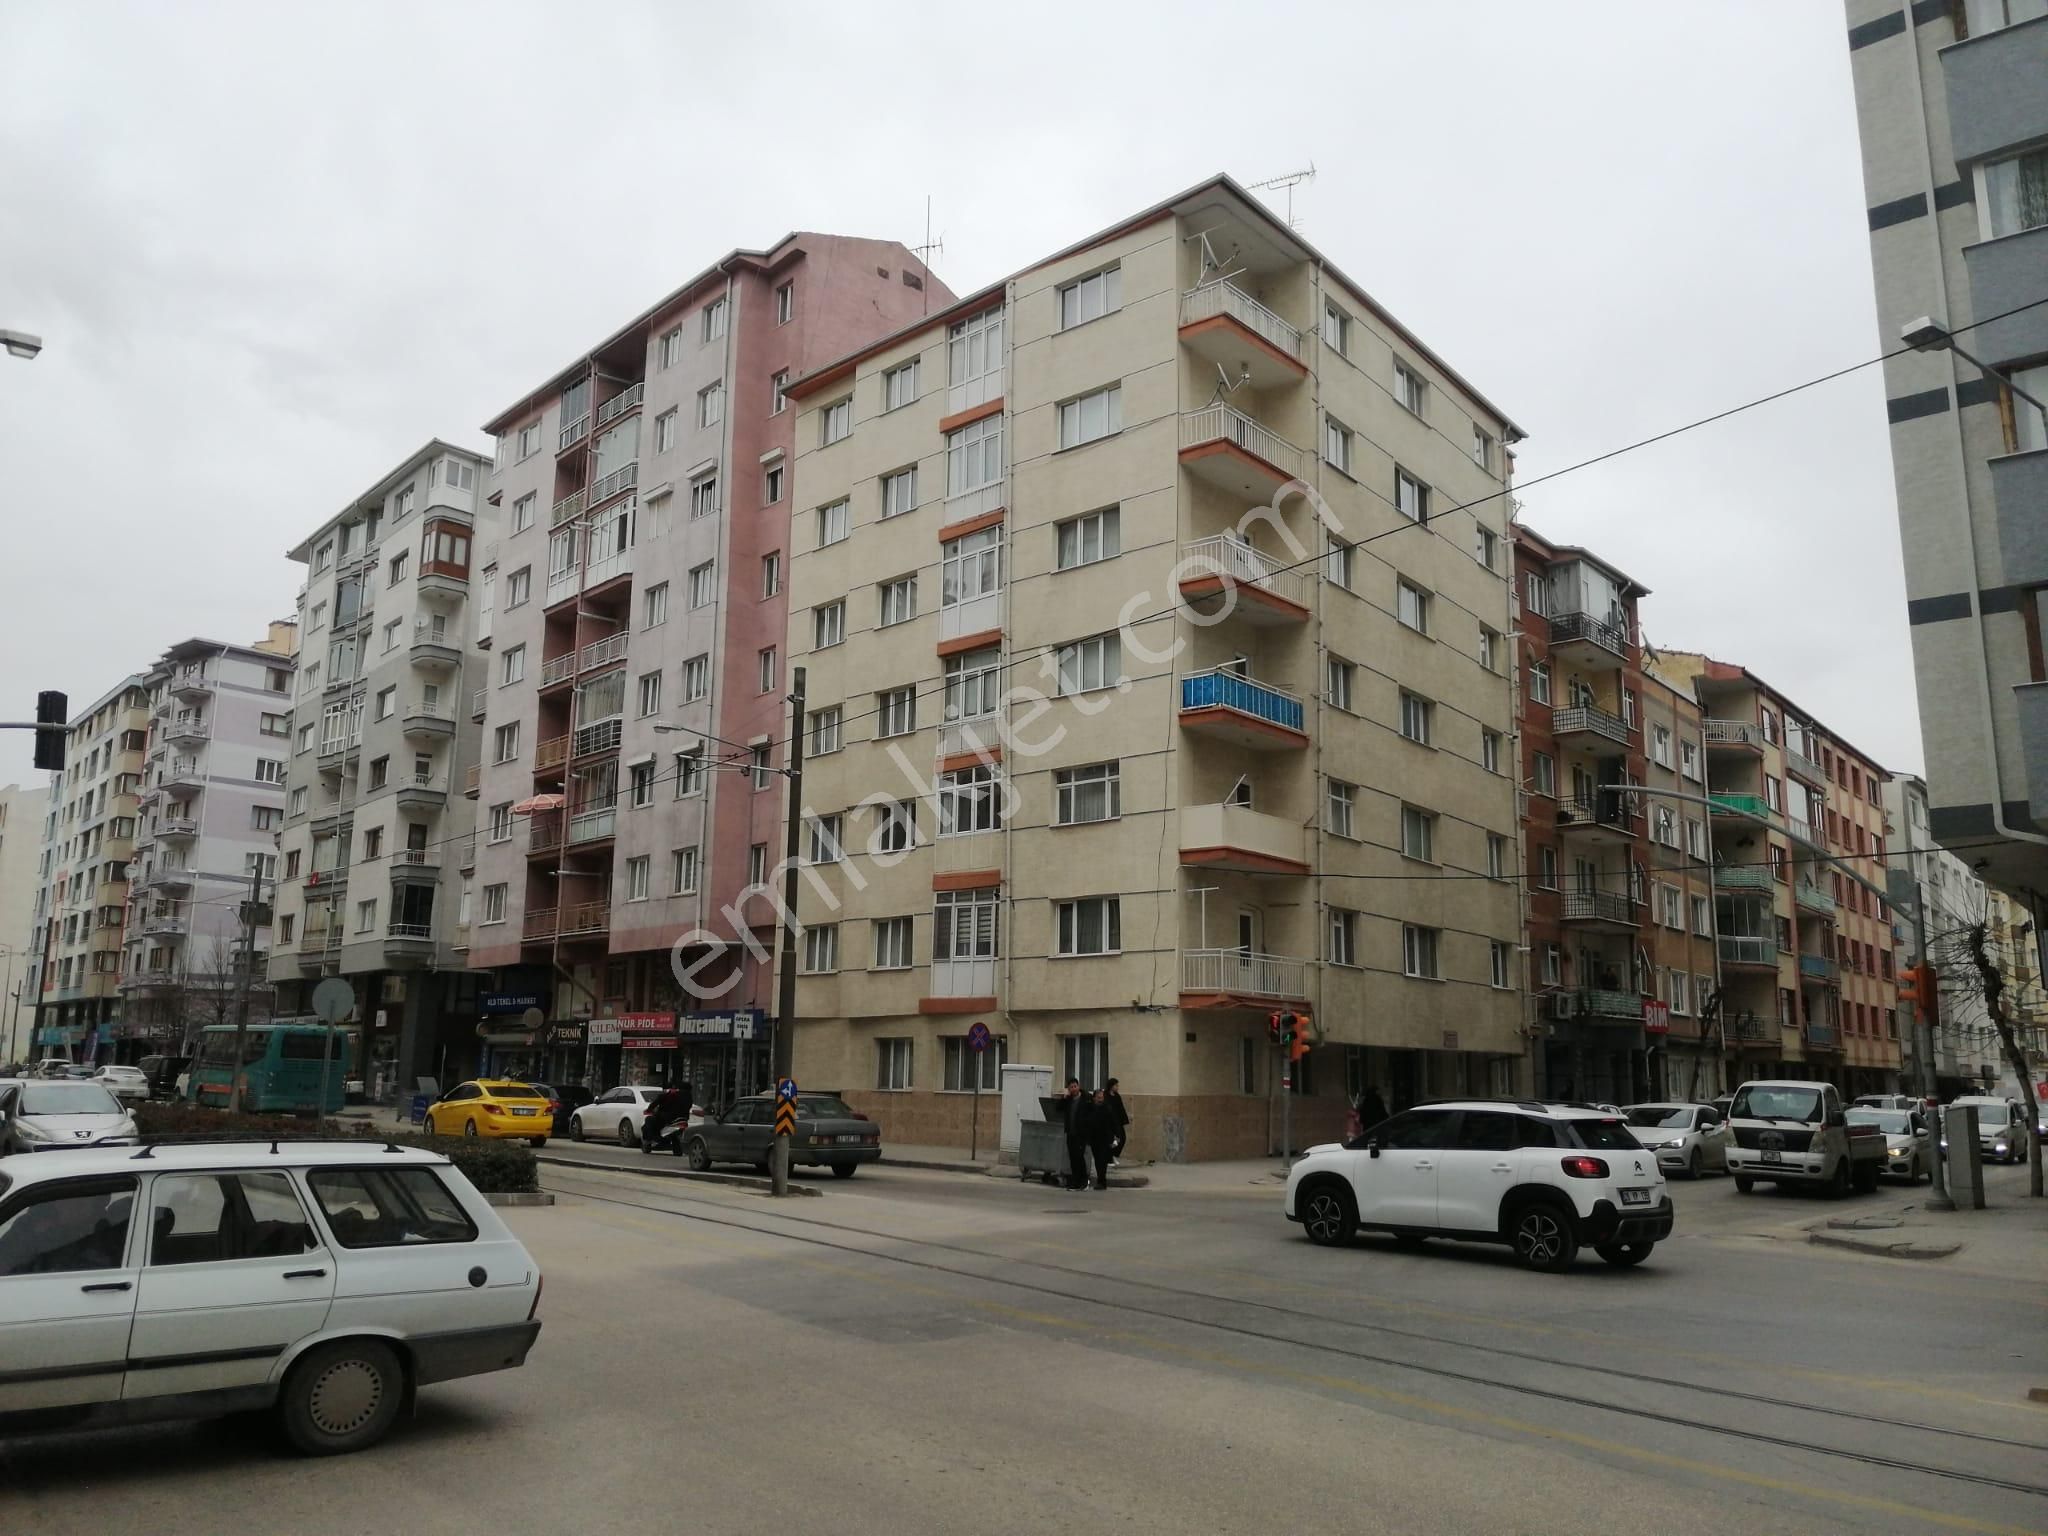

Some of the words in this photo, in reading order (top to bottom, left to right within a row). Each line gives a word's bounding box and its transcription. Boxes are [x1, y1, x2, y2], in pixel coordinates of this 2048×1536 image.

[617, 1018, 635, 1029] NUR
[637, 1017, 656, 1029] PİDE
[1645, 1001, 1668, 1027] BİM
